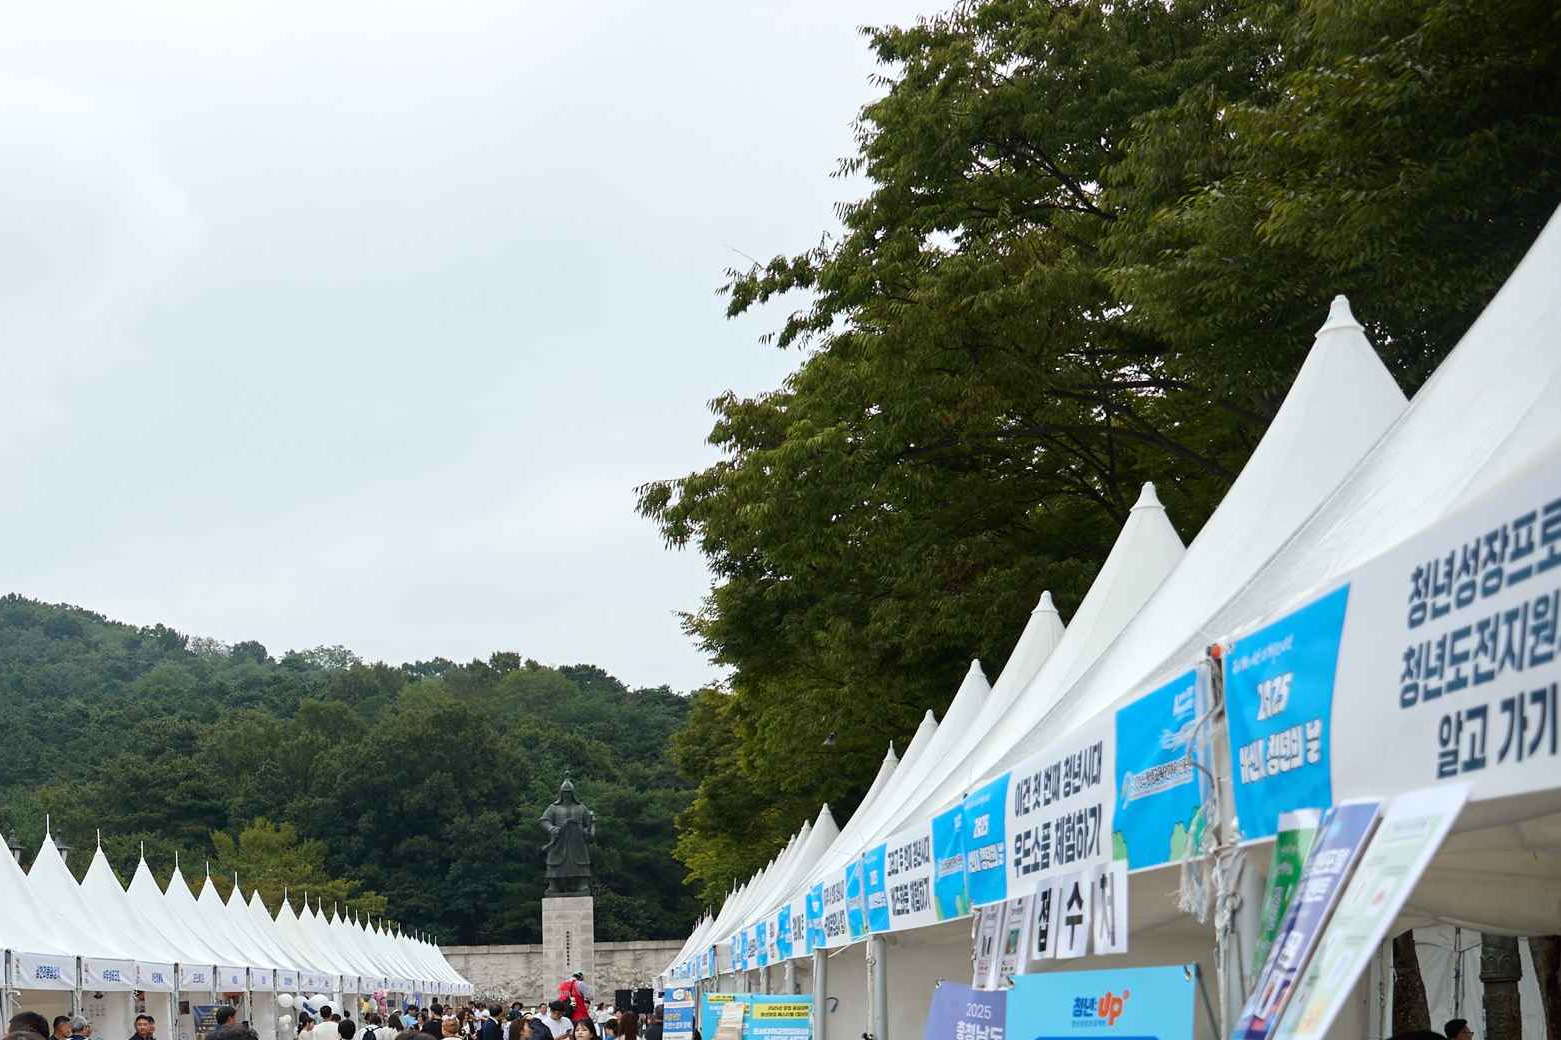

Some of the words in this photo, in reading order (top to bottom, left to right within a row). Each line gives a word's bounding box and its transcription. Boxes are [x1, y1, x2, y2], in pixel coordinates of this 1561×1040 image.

[1305, 719, 1323, 764] 날
[1436, 703, 1489, 780] 알고
[1497, 682, 1558, 765] 가기
[1063, 740, 1103, 798] 청년시대
[1014, 822, 1052, 879] 우드소품
[1054, 803, 1102, 866] 체험하기
[966, 1002, 992, 1019] 2025
